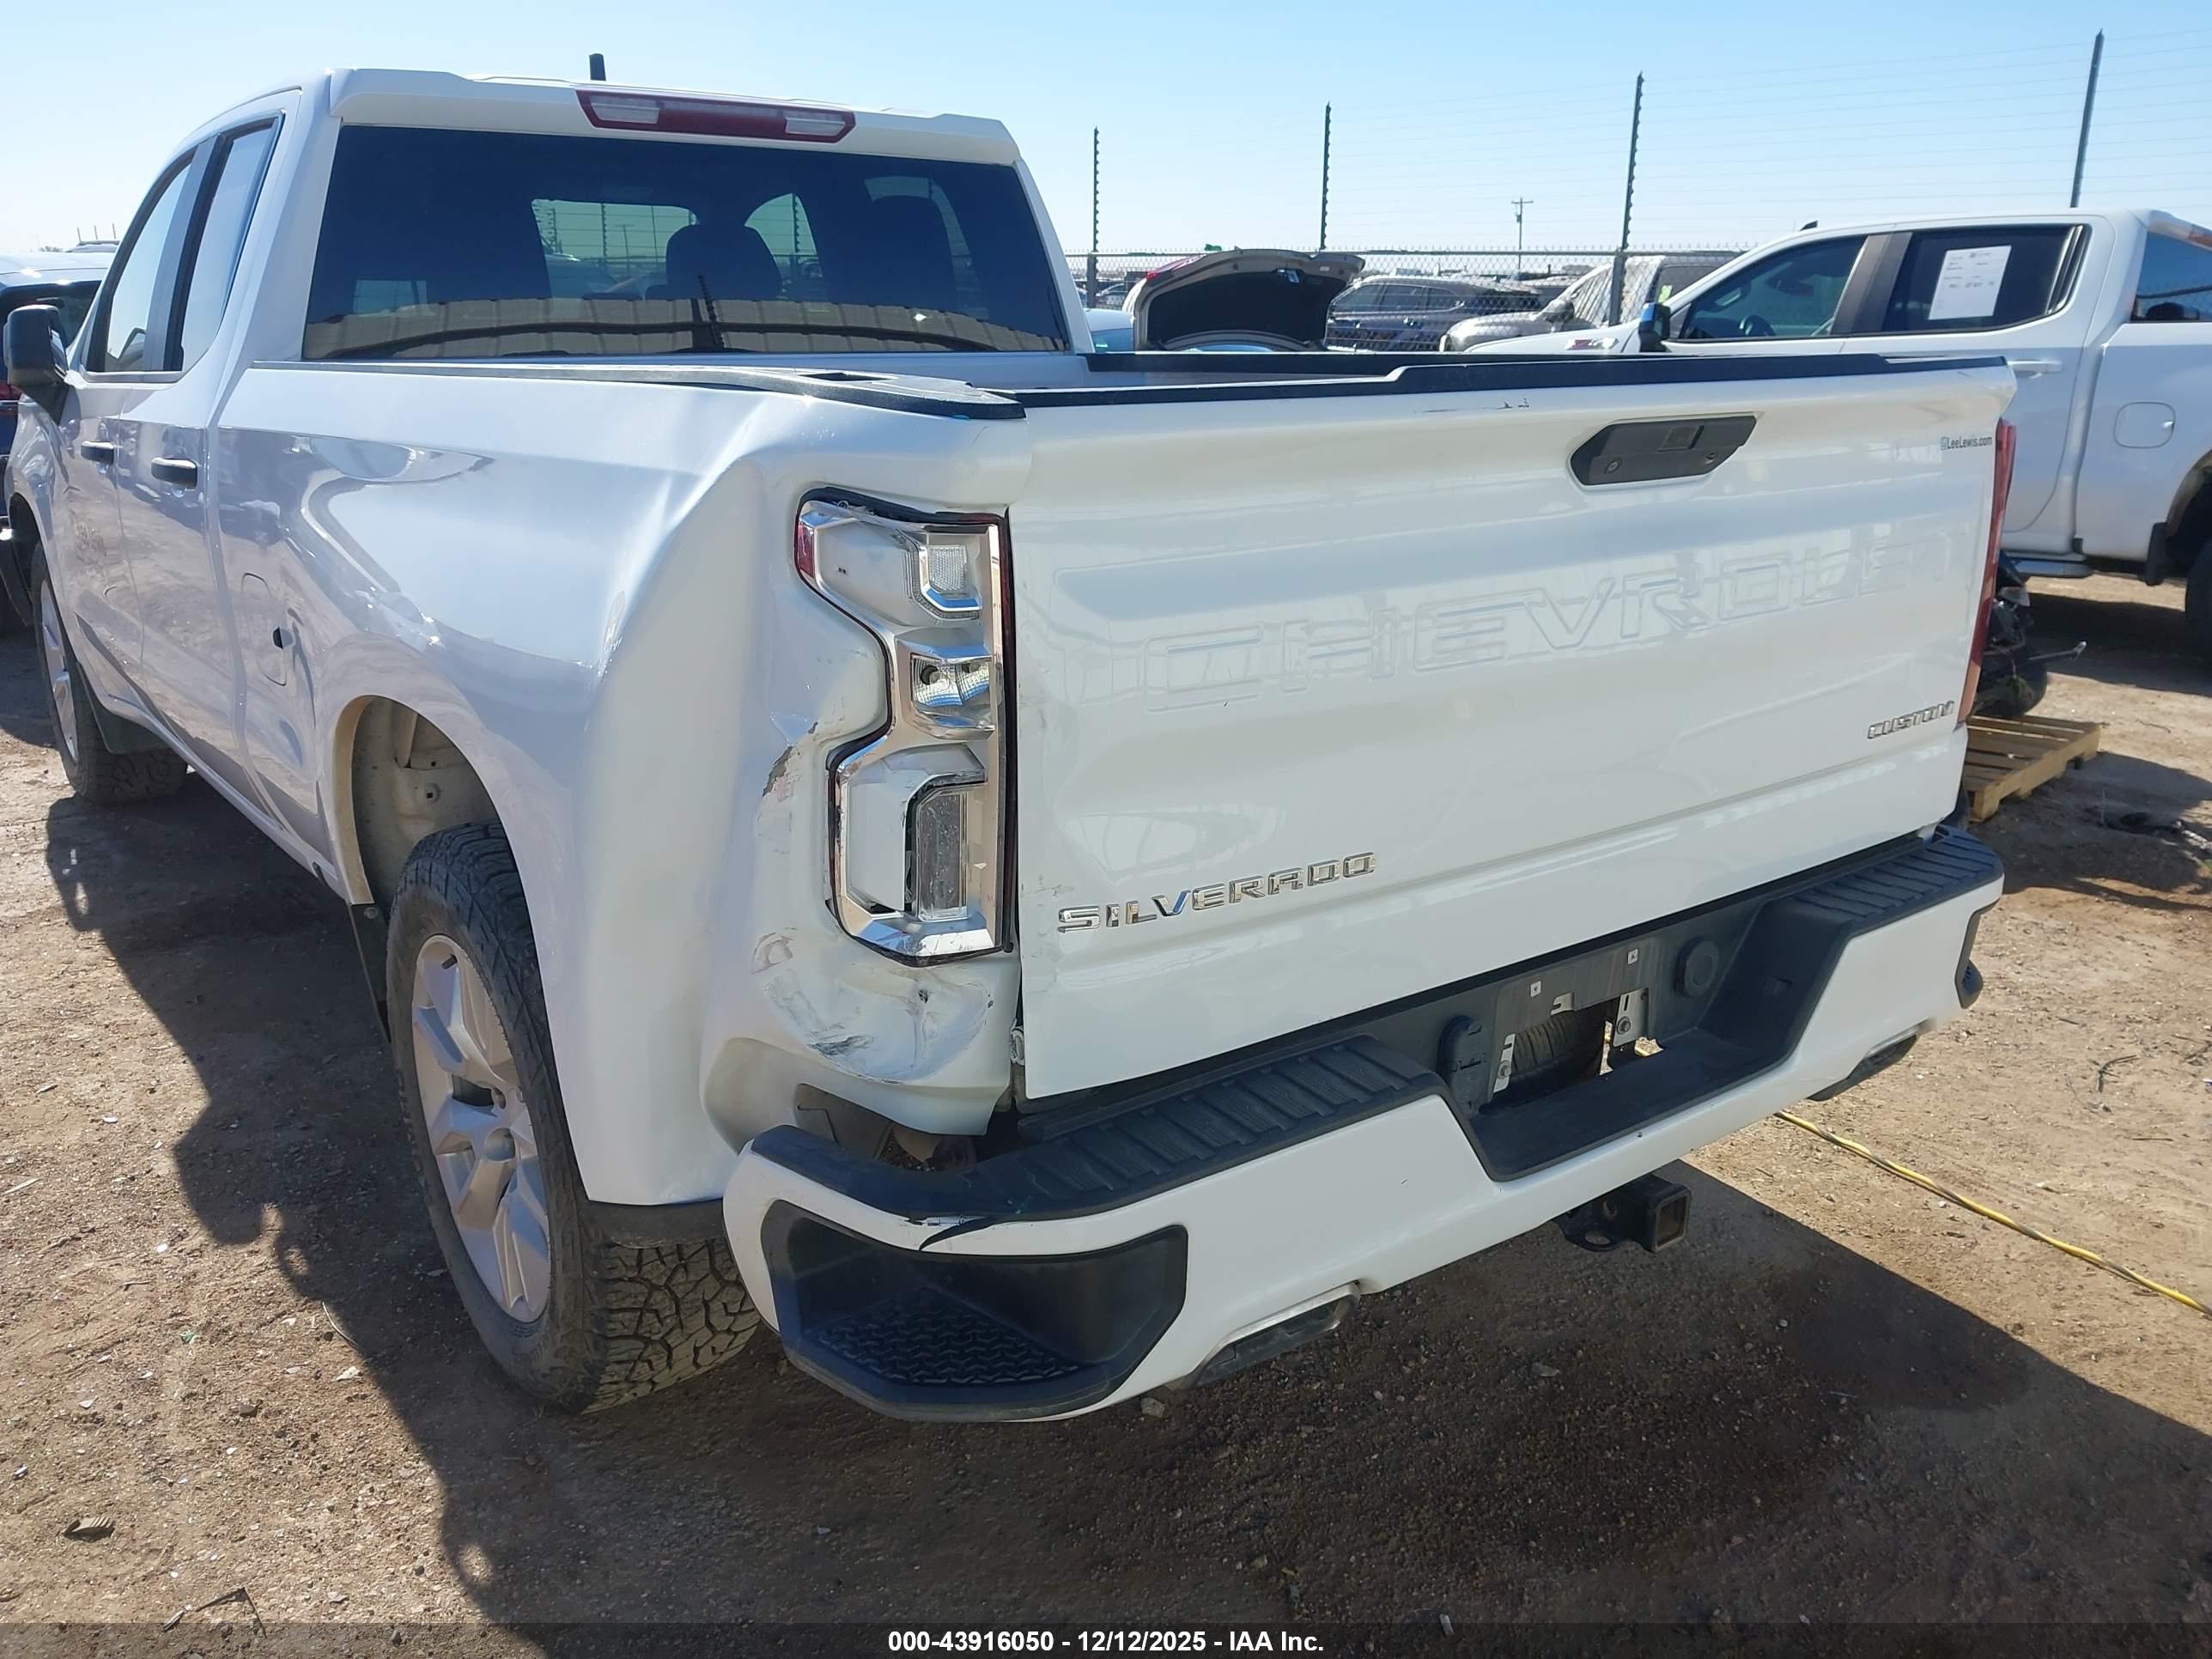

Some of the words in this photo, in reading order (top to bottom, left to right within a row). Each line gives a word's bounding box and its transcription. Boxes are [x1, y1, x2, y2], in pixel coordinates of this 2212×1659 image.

[1947, 435, 1993, 449] LeeLewis.com
[1143, 527, 1969, 713] CHEVROLET
[1868, 701, 1955, 739] CUSTOM
[1057, 851, 1376, 934] SILVERADO
